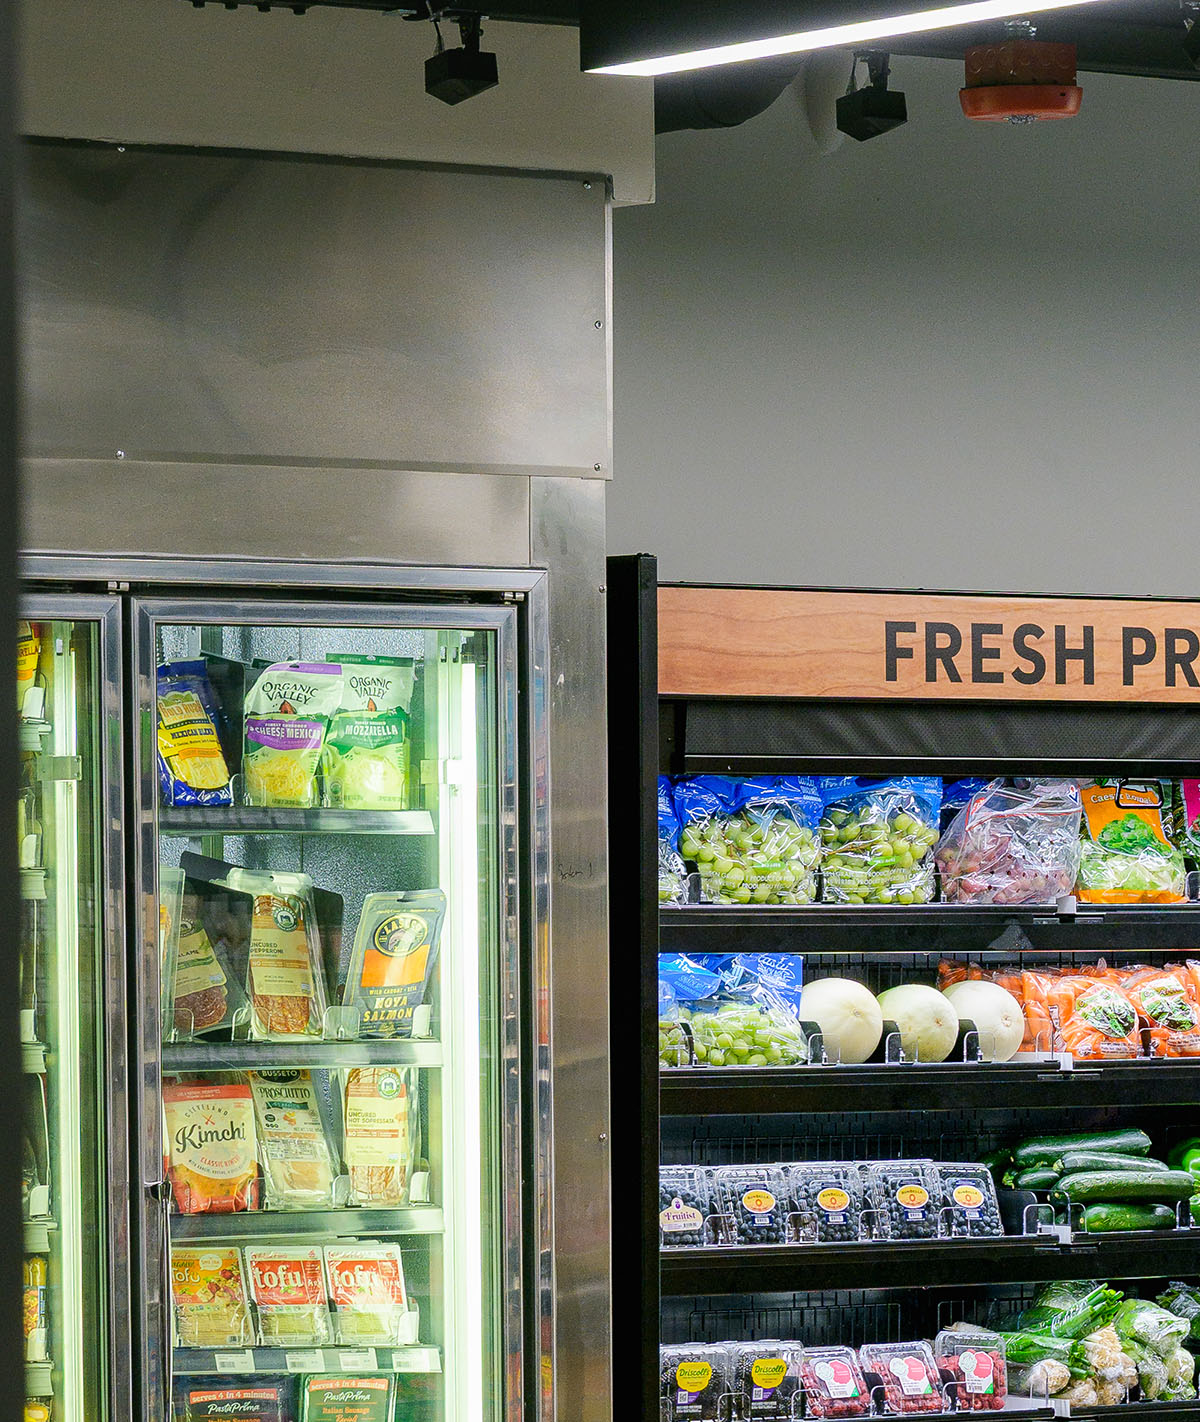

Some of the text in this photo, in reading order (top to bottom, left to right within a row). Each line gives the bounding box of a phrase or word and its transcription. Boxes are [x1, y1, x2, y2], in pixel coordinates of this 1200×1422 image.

[884, 621, 1094, 685] FRESH
[350, 676, 392, 690] ORGANIC
[262, 682, 318, 698] ORGANIC
[355, 687, 387, 699] VALLEY
[266, 691, 312, 705] VALLEY
[254, 726, 284, 739] CHEESE
[345, 724, 398, 735] MOZZARELLA
[374, 996, 408, 1009] NOVA
[363, 1007, 413, 1022] SALMON
[257, 1086, 311, 1100] PROSCIUTTO
[175, 1121, 245, 1153] Kimchi
[664, 1212, 696, 1221] Fruitist
[254, 1264, 303, 1289] tofu
[679, 1368, 709, 1377] Driscoll's
[754, 1365, 784, 1373] Driscoll's
[192, 1394, 216, 1402] serves
[243, 1391, 274, 1399] minutes
